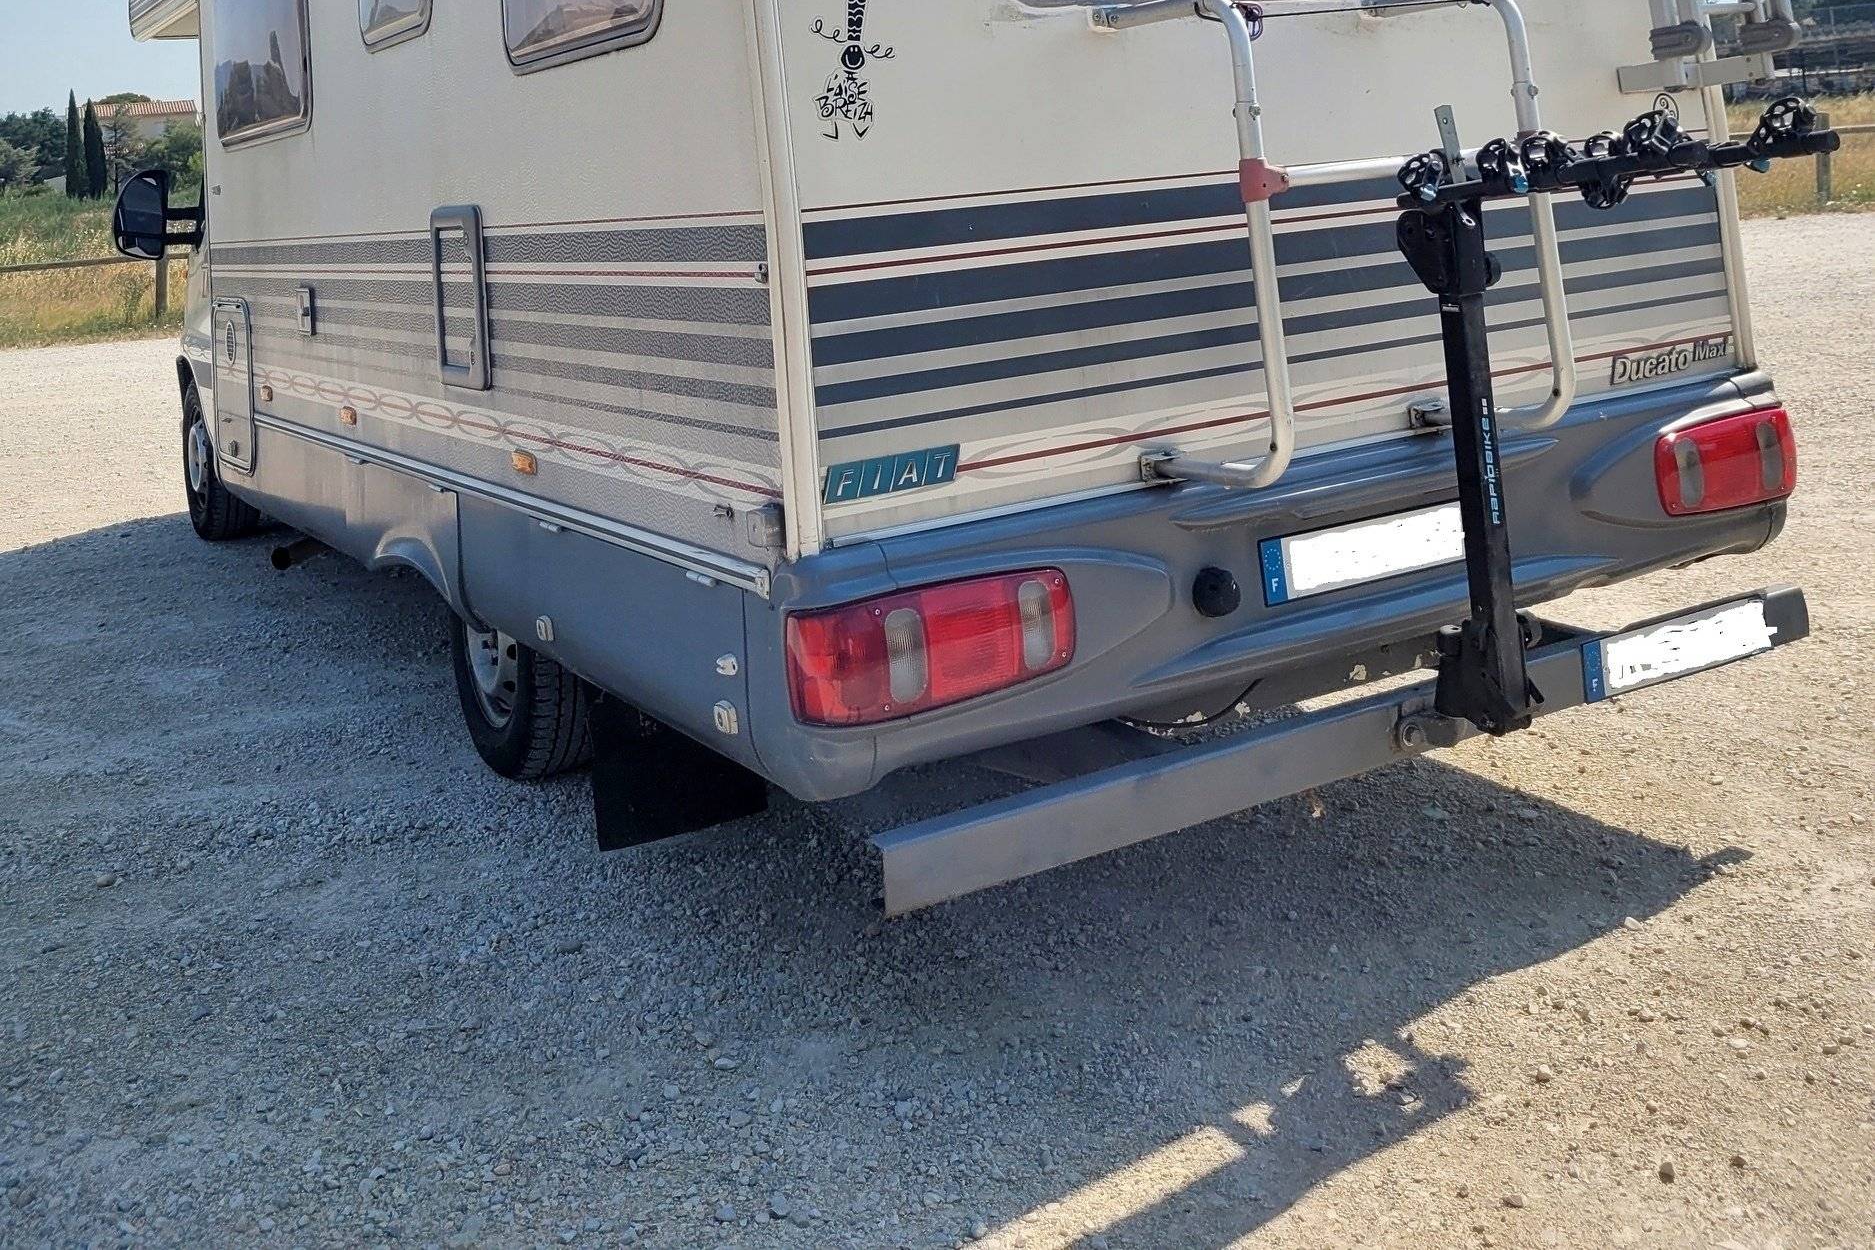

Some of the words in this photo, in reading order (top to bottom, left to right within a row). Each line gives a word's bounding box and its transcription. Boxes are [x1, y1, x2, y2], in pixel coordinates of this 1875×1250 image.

[1610, 345, 1692, 385] Ducato
[836, 452, 951, 497] FIAT
[1271, 578, 1279, 592] F
